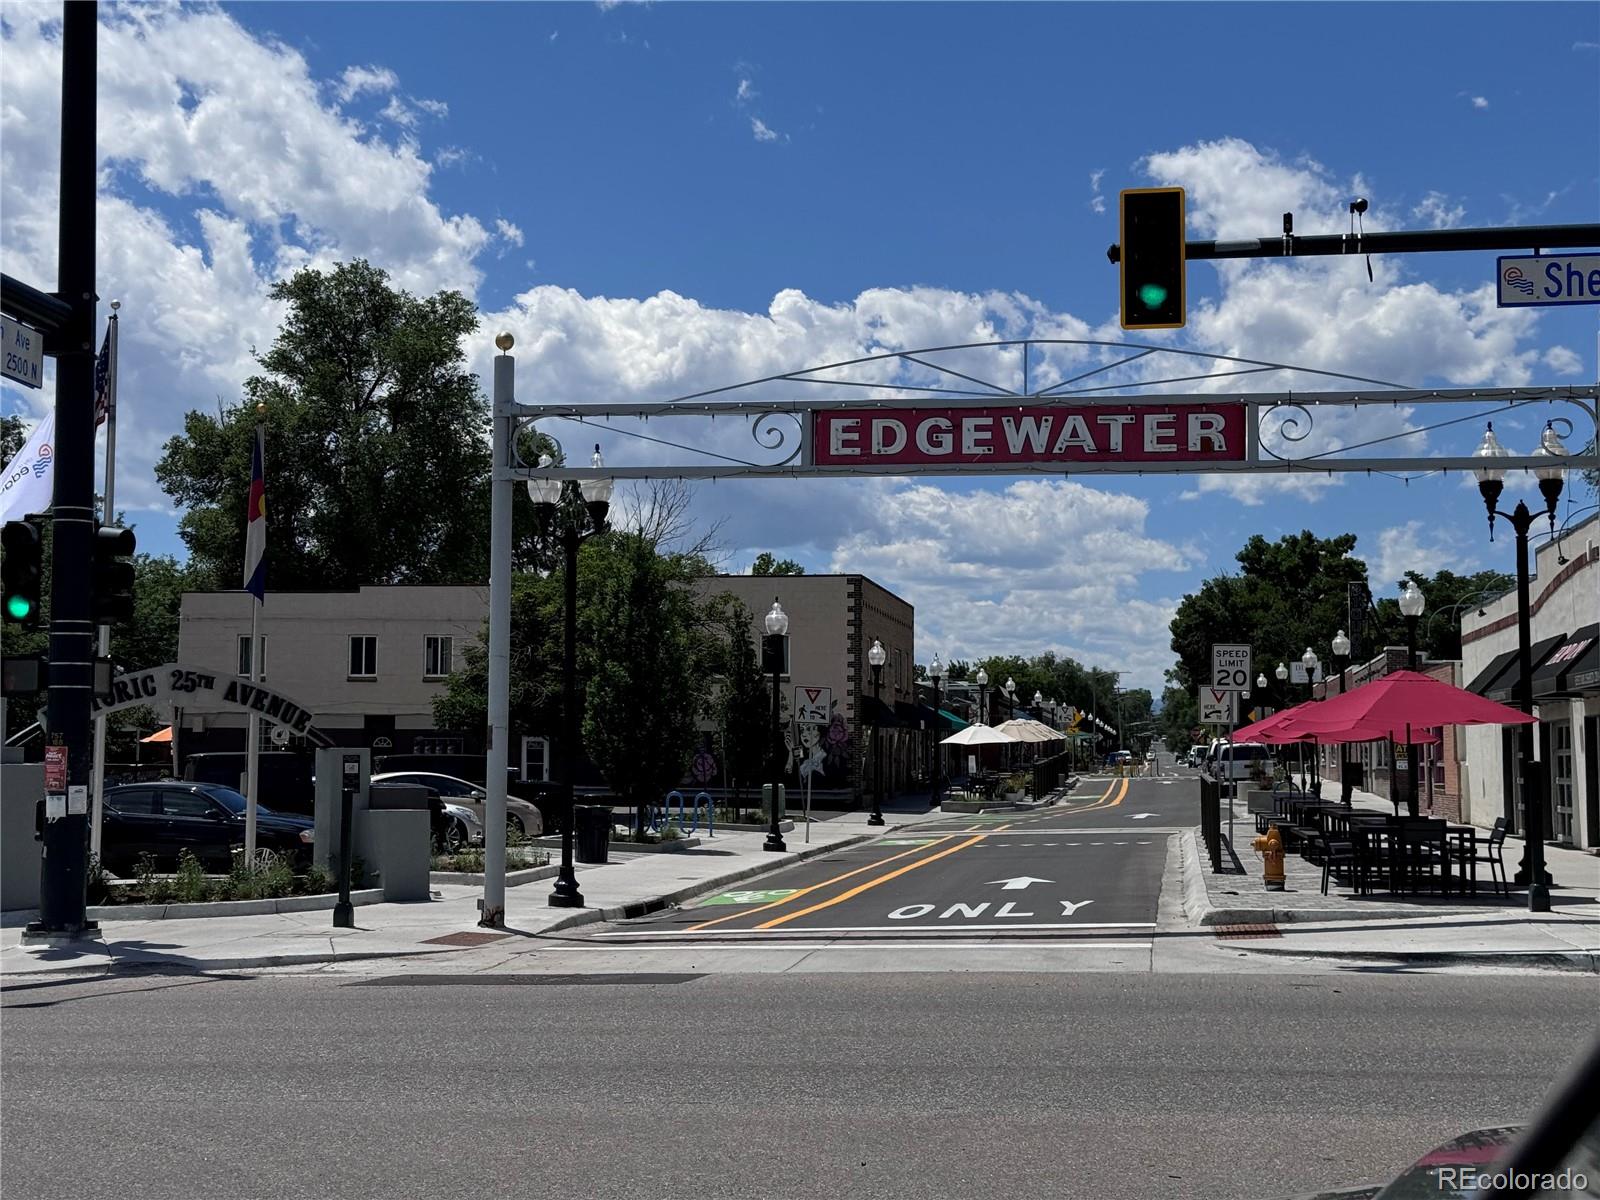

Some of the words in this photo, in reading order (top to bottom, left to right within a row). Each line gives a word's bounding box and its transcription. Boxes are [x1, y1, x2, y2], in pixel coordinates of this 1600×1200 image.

[1544, 262, 1600, 298] She
[15, 329, 30, 351] Ave
[6, 352, 28, 376] 2500
[31, 362, 37, 380] N
[829, 413, 1229, 456] EDGEWATER
[1216, 650, 1249, 658] SPEED
[1217, 669, 1247, 686] 20
[223, 680, 313, 733] AVENUE
[887, 900, 1095, 919] ONLY
